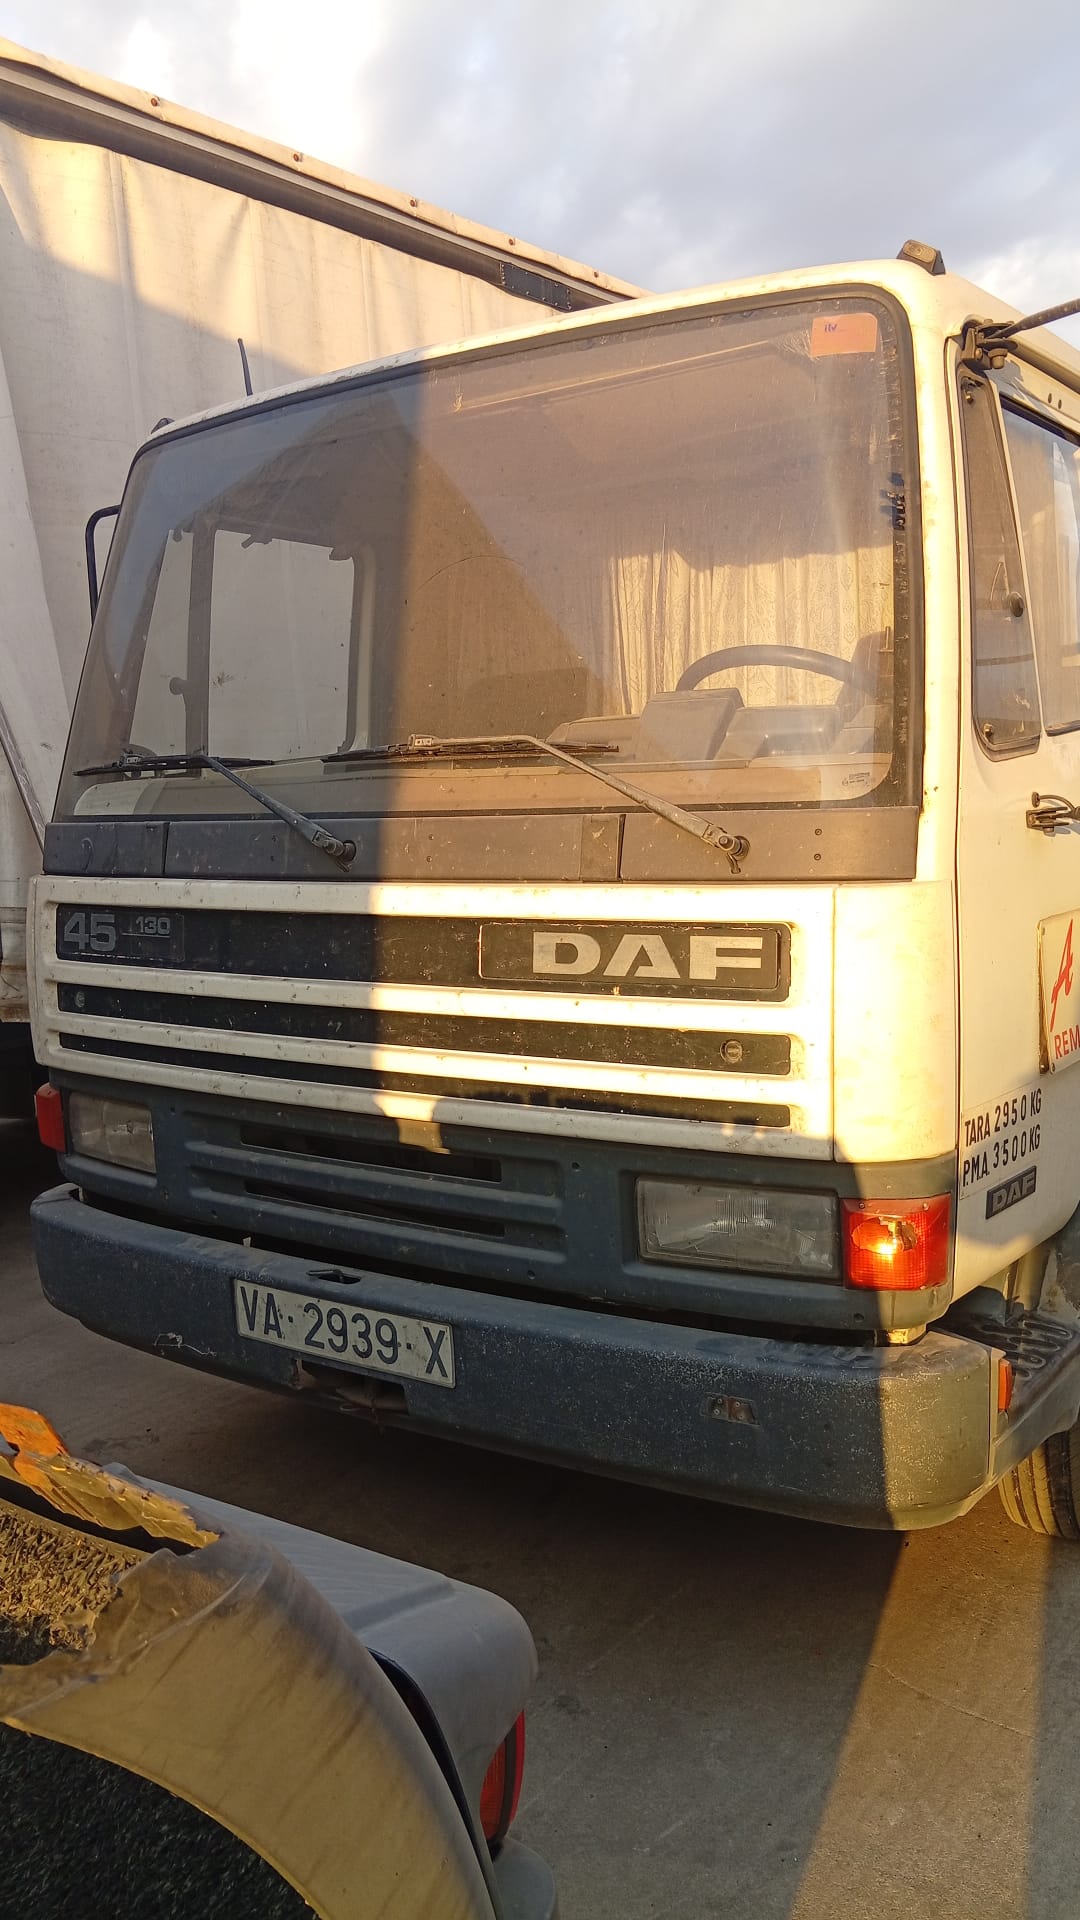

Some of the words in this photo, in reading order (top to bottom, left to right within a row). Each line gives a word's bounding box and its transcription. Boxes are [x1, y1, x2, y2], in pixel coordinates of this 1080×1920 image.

[63, 912, 117, 951] 45
[135, 916, 171, 935] 130
[532, 931, 763, 980] DAF
[964, 1112, 991, 1147] TARA
[994, 1094, 1027, 1132] 2950
[1030, 1088, 1042, 1117] KG
[962, 1151, 990, 1187] P.M.A.
[993, 1131, 1027, 1169] 3500
[1029, 1124, 1041, 1153] KG
[992, 1173, 1035, 1213] DAF
